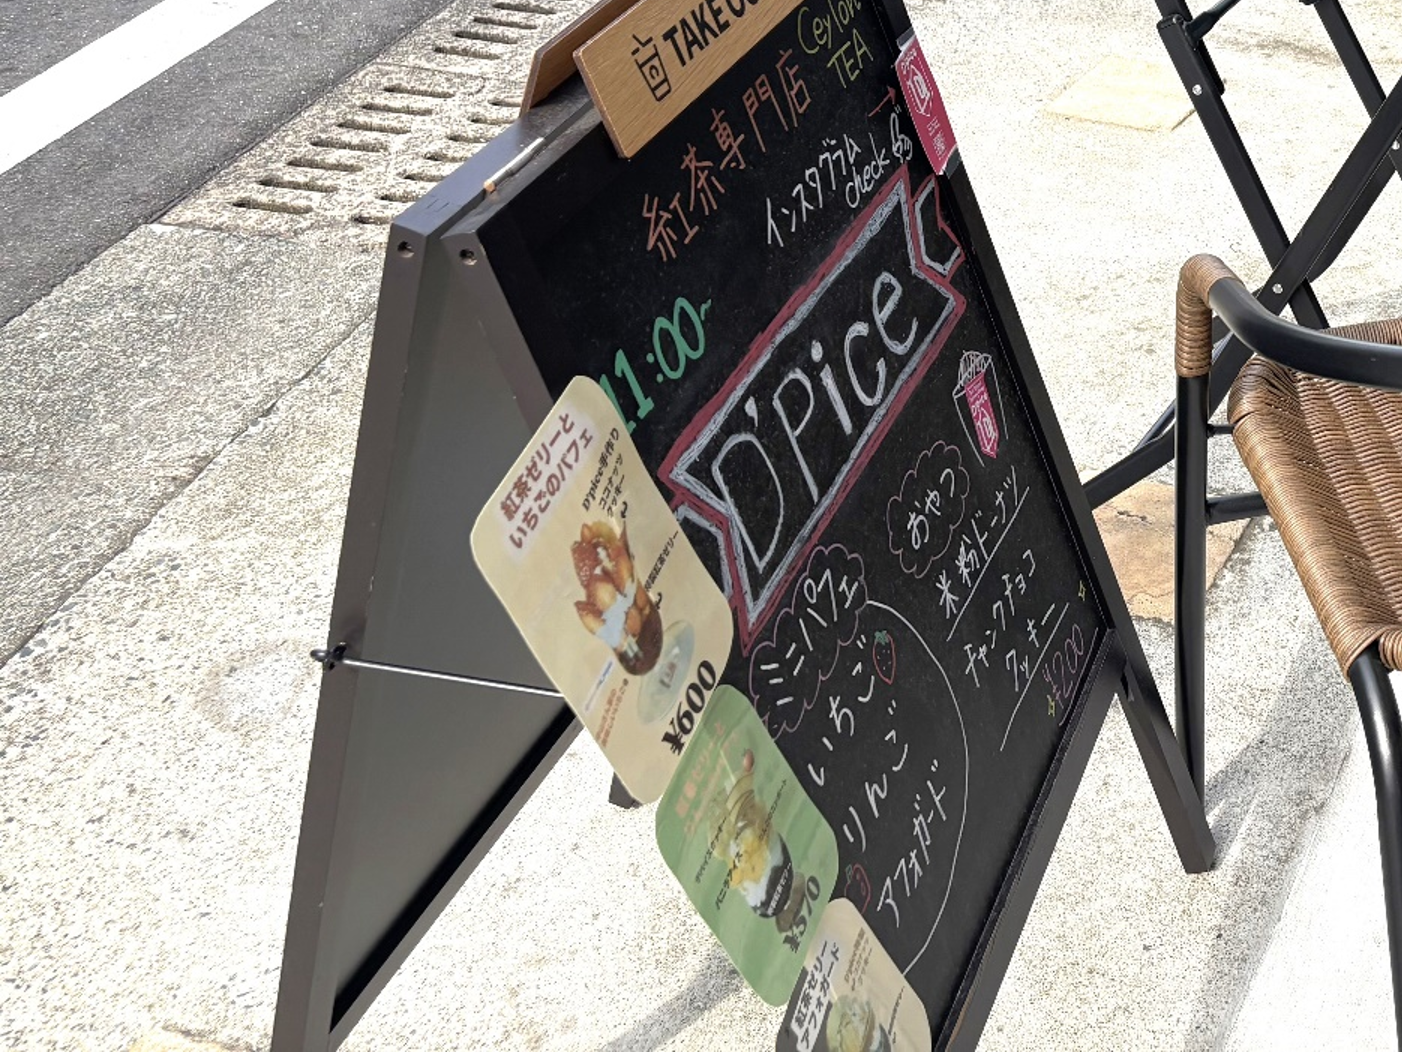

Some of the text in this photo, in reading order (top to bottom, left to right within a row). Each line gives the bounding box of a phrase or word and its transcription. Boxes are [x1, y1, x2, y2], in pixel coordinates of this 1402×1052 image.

[826, 28, 874, 89] TEA
[641, 48, 812, 263] 紅茶専門店
[765, 134, 862, 248] インスタグラム
[844, 131, 891, 209] check
[500, 412, 576, 522] 紅茶ゼリーと
[509, 427, 594, 549] いちごのパフェ
[598, 453, 624, 510] ココナッツ
[606, 474, 626, 518] クッキー
[906, 467, 956, 551] おやつ
[934, 464, 1019, 620] 米粉ドーナツ
[759, 567, 860, 707] ミニパフェ
[963, 548, 1036, 688] チャンクチョコ
[1004, 602, 1056, 693] クッキー
[1041, 623, 1085, 710] ¥200
[661, 659, 718, 757] ¥600
[807, 633, 876, 788] いちご
[841, 698, 909, 853] りんご
[875, 757, 948, 930] アフォガード
[794, 939, 828, 1029] 紅茶ゼリー
[800, 941, 840, 1050] アフォガード
